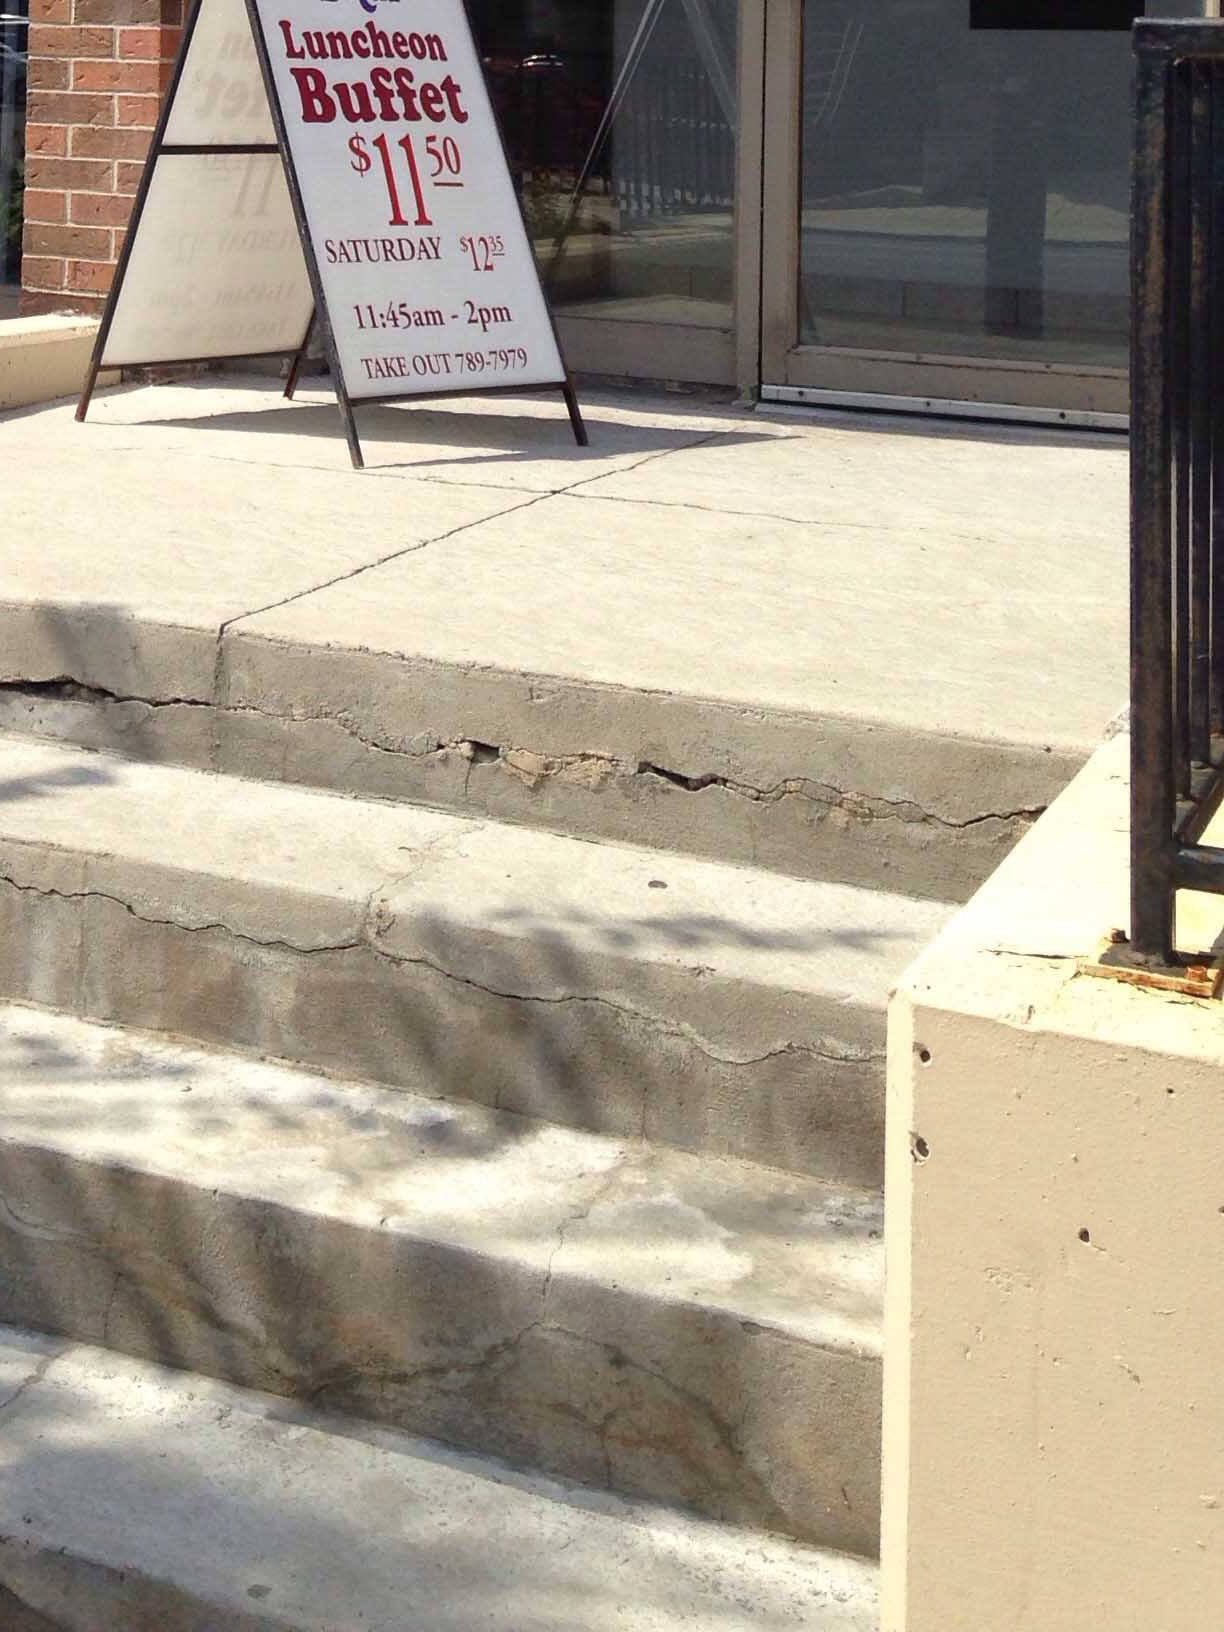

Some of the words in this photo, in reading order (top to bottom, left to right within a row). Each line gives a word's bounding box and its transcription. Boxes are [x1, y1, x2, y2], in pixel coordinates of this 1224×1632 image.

[278, 19, 449, 62] Luncheon
[289, 67, 470, 124] Buffet
[325, 236, 442, 264] SATURDAY
[353, 300, 446, 330] 11:45am
[464, 300, 513, 333] 2pm
[360, 356, 410, 380] TAKE
[412, 352, 452, 376] OUT
[455, 347, 528, 374] 789-7979
